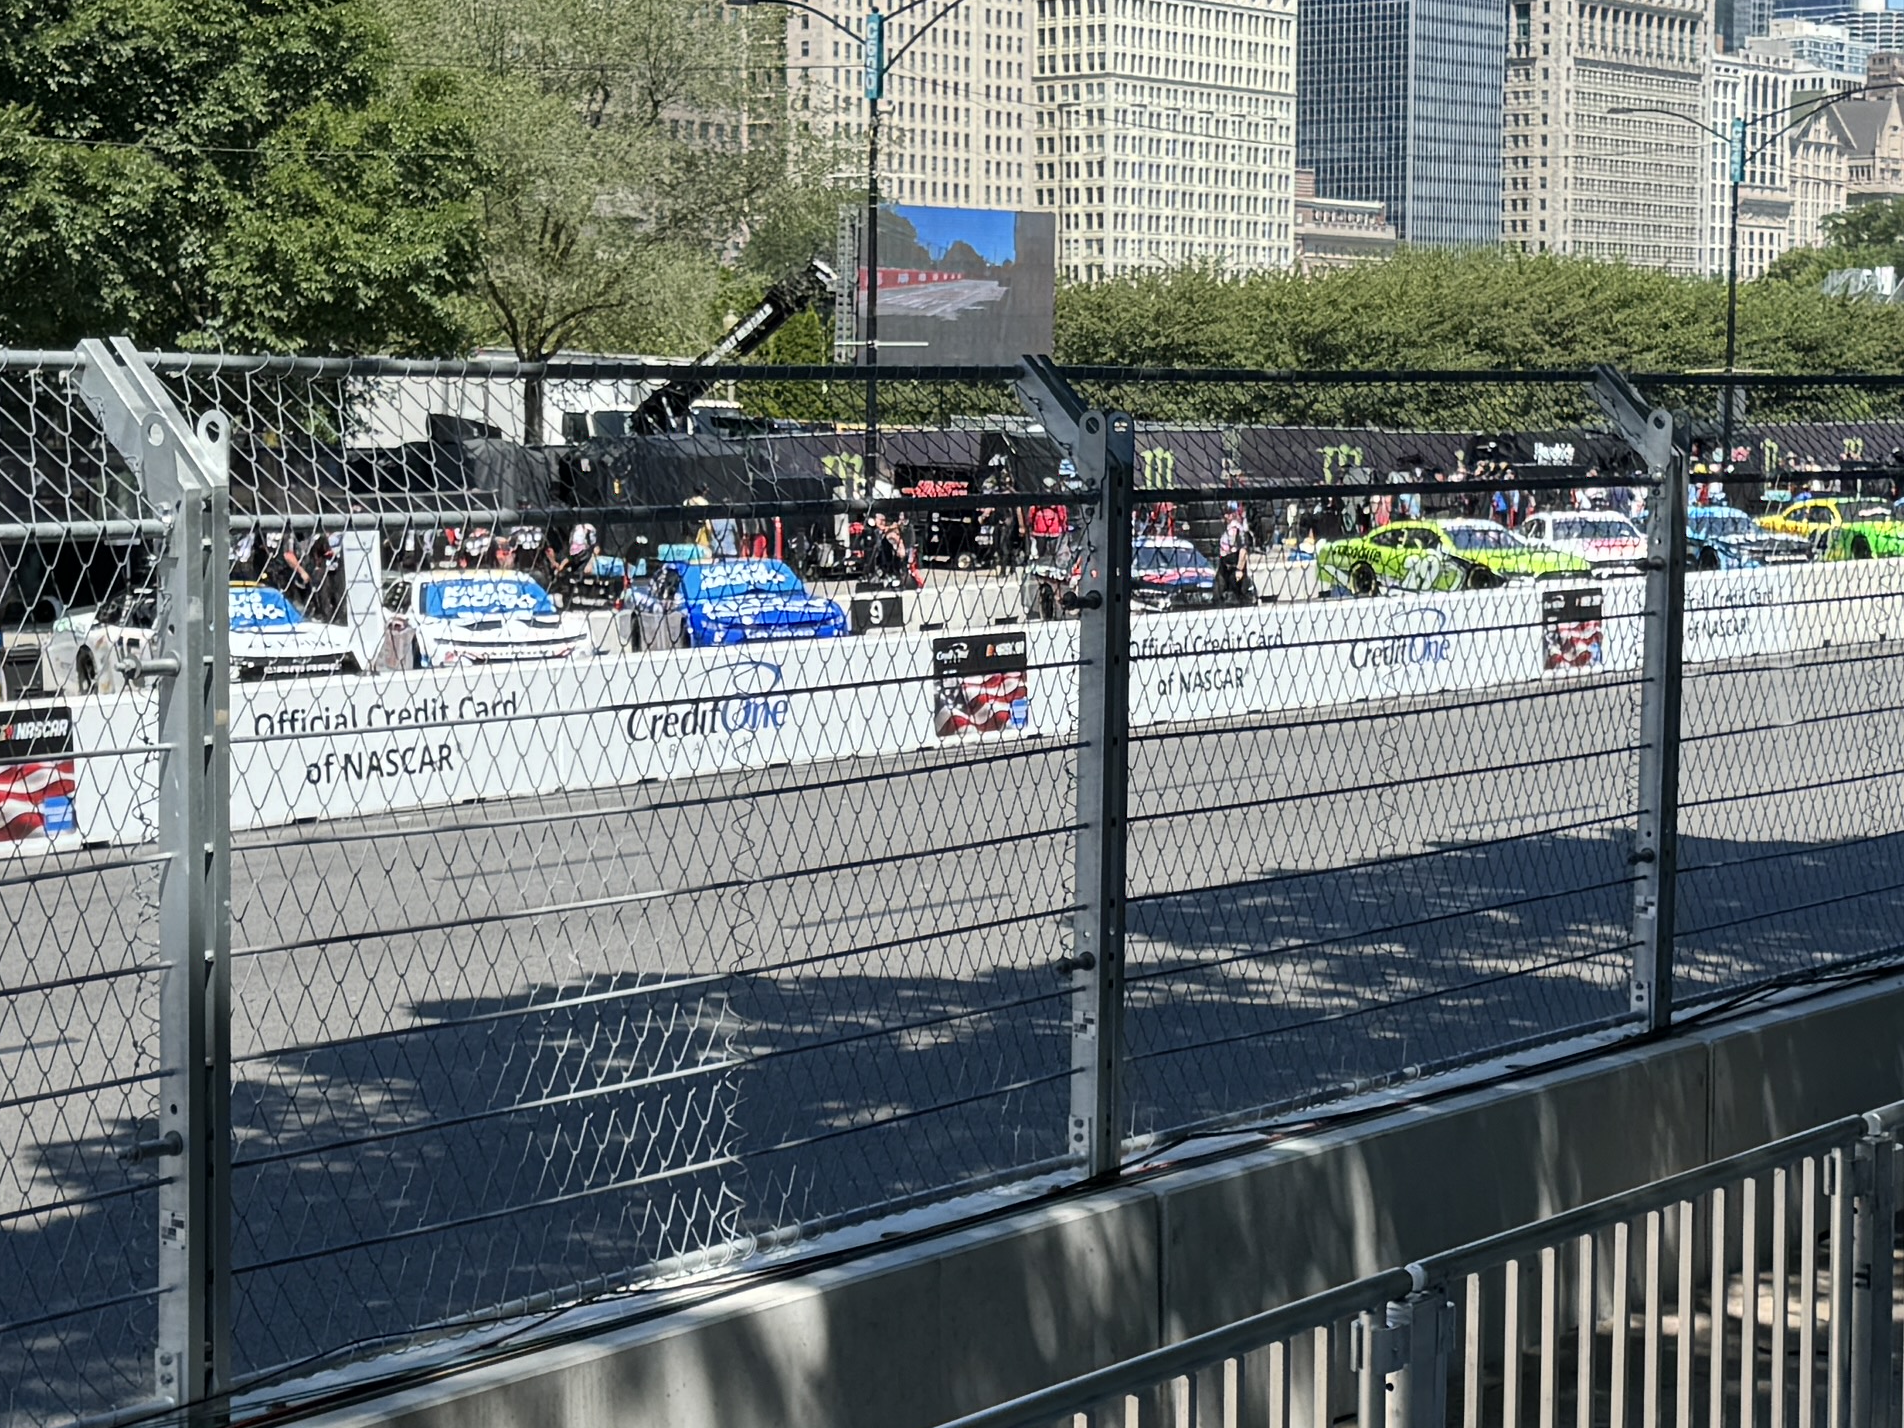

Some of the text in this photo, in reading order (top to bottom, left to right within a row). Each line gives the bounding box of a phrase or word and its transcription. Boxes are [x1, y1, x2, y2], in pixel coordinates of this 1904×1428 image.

[869, 603, 883, 625] 9
[1248, 626, 1283, 649] Card
[1158, 667, 1246, 696] of NASCAR
[255, 691, 517, 736] Official Credit Card
[306, 743, 453, 785] of NASCAR
